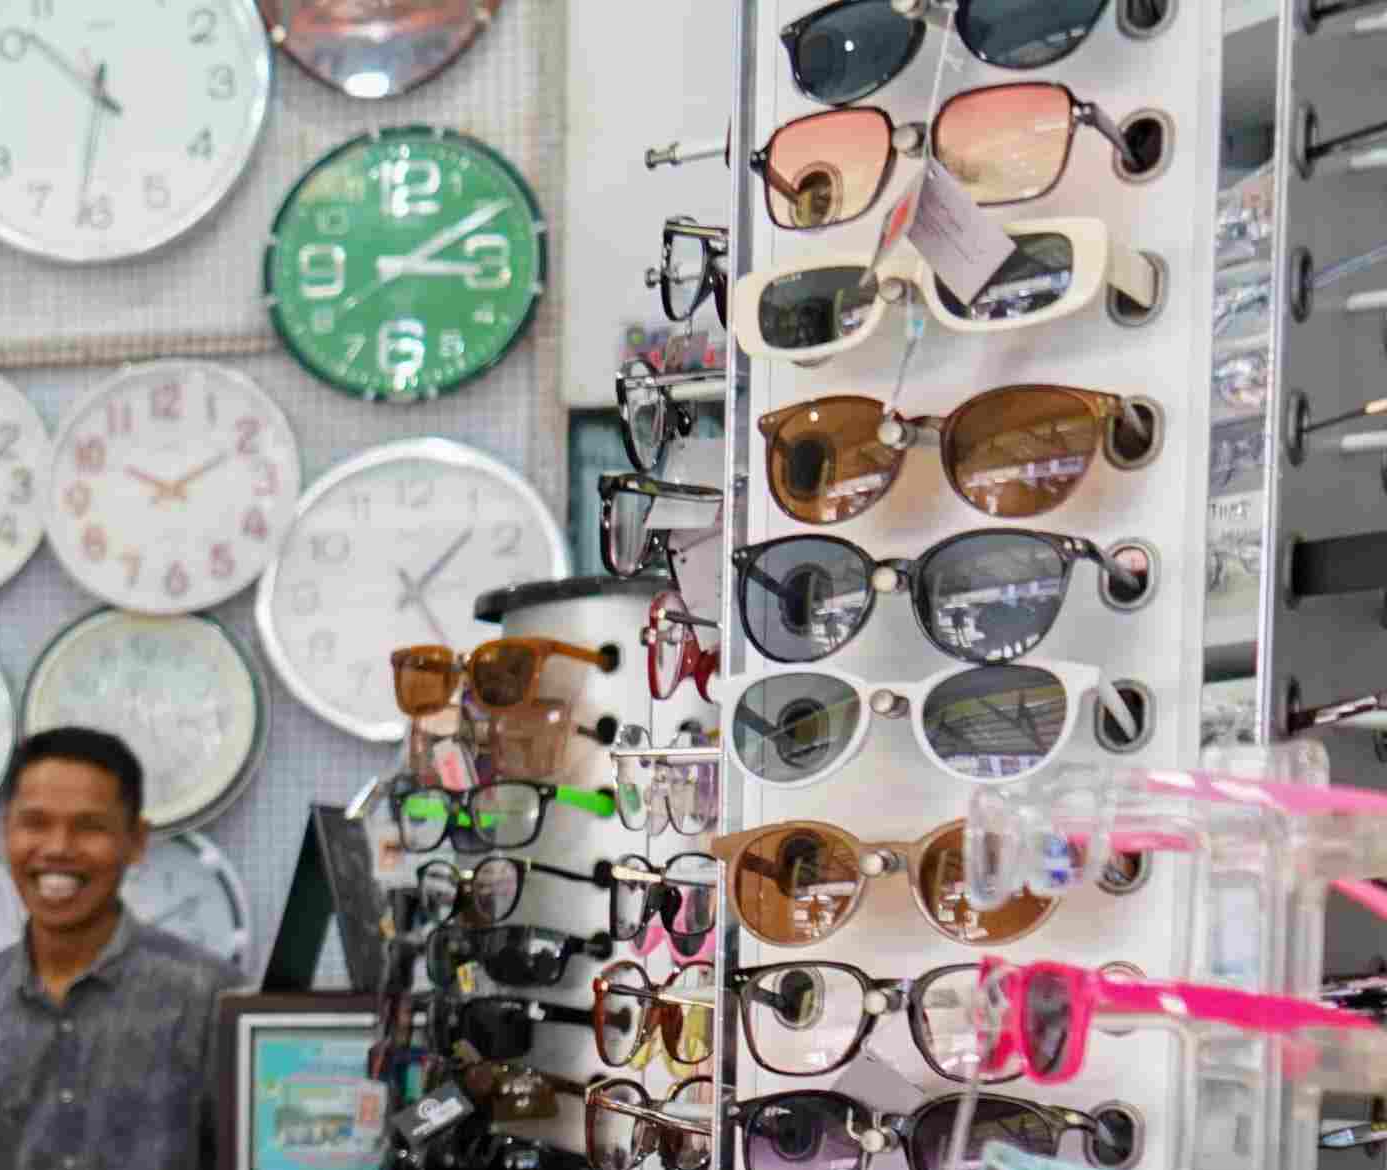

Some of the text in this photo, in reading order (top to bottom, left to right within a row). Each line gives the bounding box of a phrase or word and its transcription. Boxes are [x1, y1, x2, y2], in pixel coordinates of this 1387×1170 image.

[190, 8, 218, 45] 2
[207, 65, 236, 100] 3
[187, 128, 212, 159] 4
[379, 159, 441, 217] 12
[464, 234, 511, 289] 3
[378, 319, 425, 376] 6
[150, 382, 185, 419] 12
[235, 416, 261, 454] 2
[10, 466, 32, 503] 3
